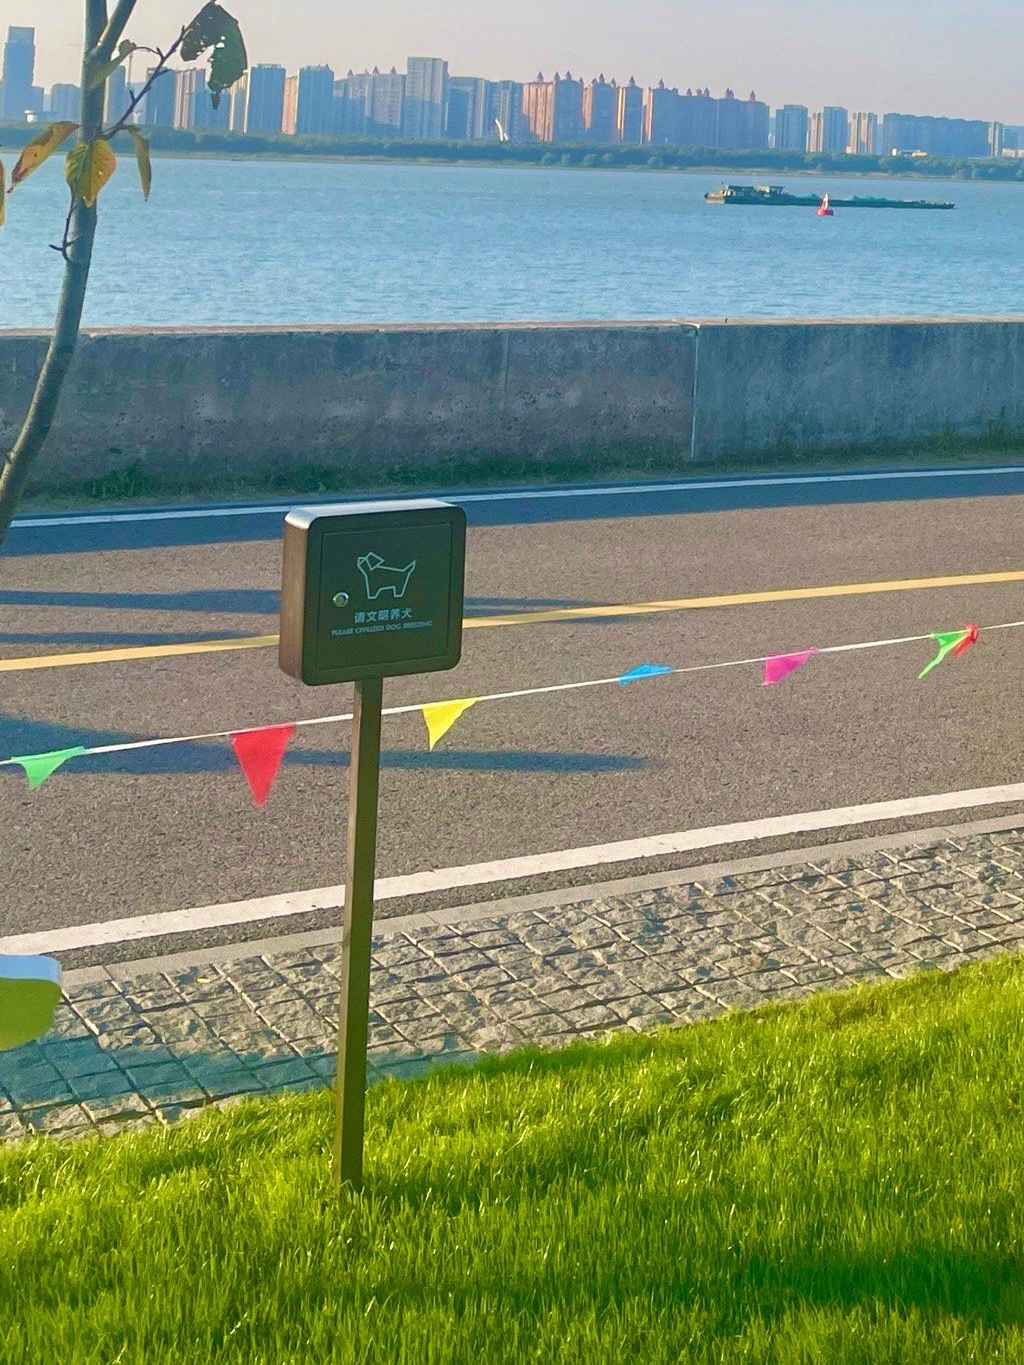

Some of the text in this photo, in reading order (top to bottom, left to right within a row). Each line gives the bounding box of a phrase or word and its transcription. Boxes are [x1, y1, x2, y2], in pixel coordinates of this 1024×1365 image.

[354, 607, 412, 624] 请文明养犬
[331, 627, 353, 636] PLEASE
[386, 623, 401, 631] DOG
